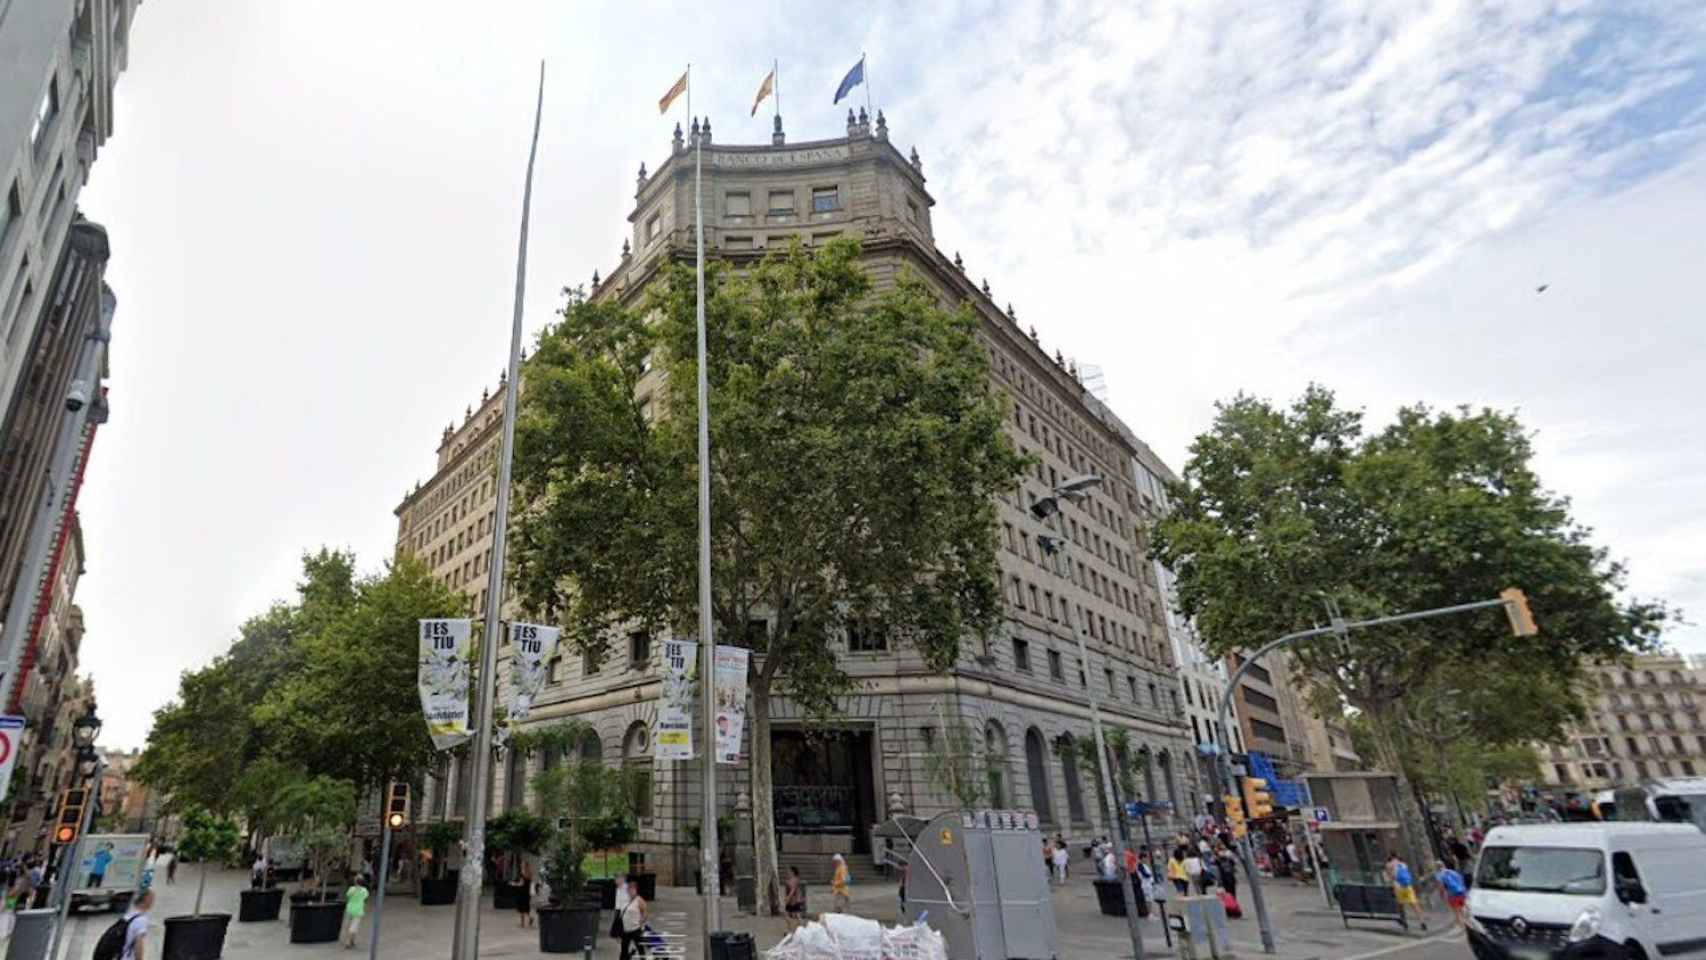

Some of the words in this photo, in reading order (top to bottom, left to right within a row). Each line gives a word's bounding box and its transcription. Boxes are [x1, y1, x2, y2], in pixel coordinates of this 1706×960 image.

[433, 622, 448, 635] ES
[522, 626, 537, 639] ES
[433, 636, 455, 649] TIU
[521, 639, 541, 653] TIU
